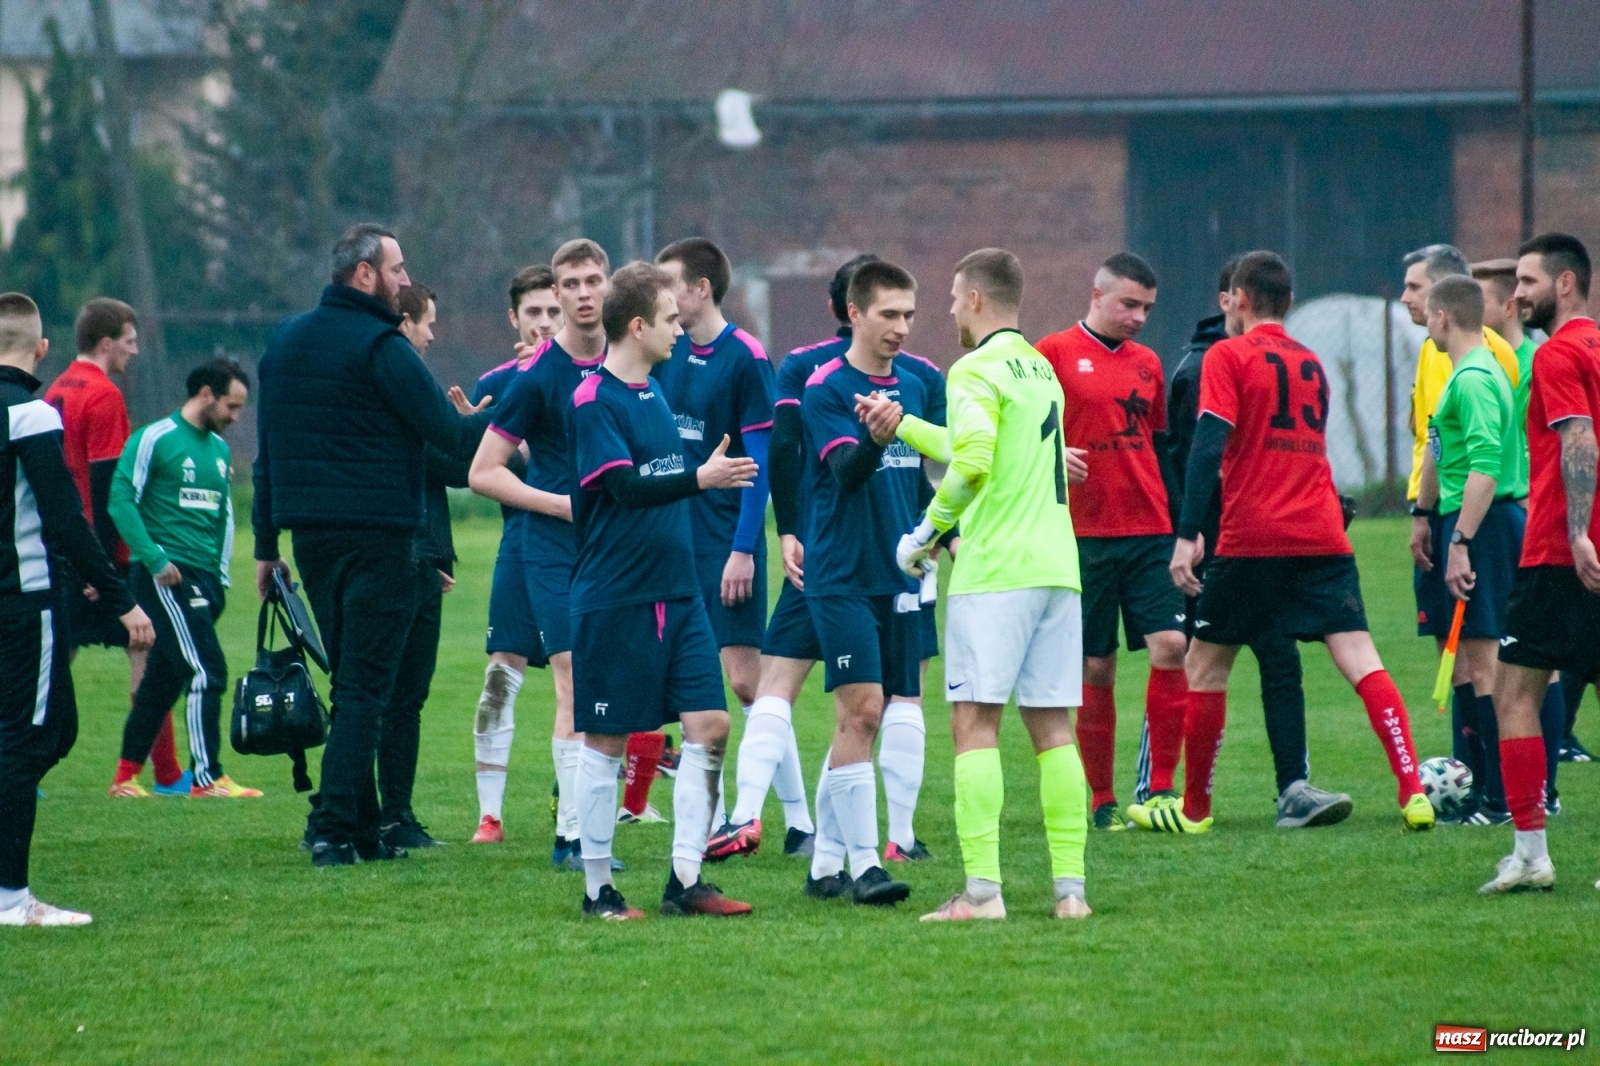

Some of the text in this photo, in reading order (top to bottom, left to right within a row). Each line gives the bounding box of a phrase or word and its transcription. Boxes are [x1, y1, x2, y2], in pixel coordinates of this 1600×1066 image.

[1029, 359, 1055, 381] KU
[1265, 351, 1329, 434] 13
[1040, 400, 1067, 505] 1
